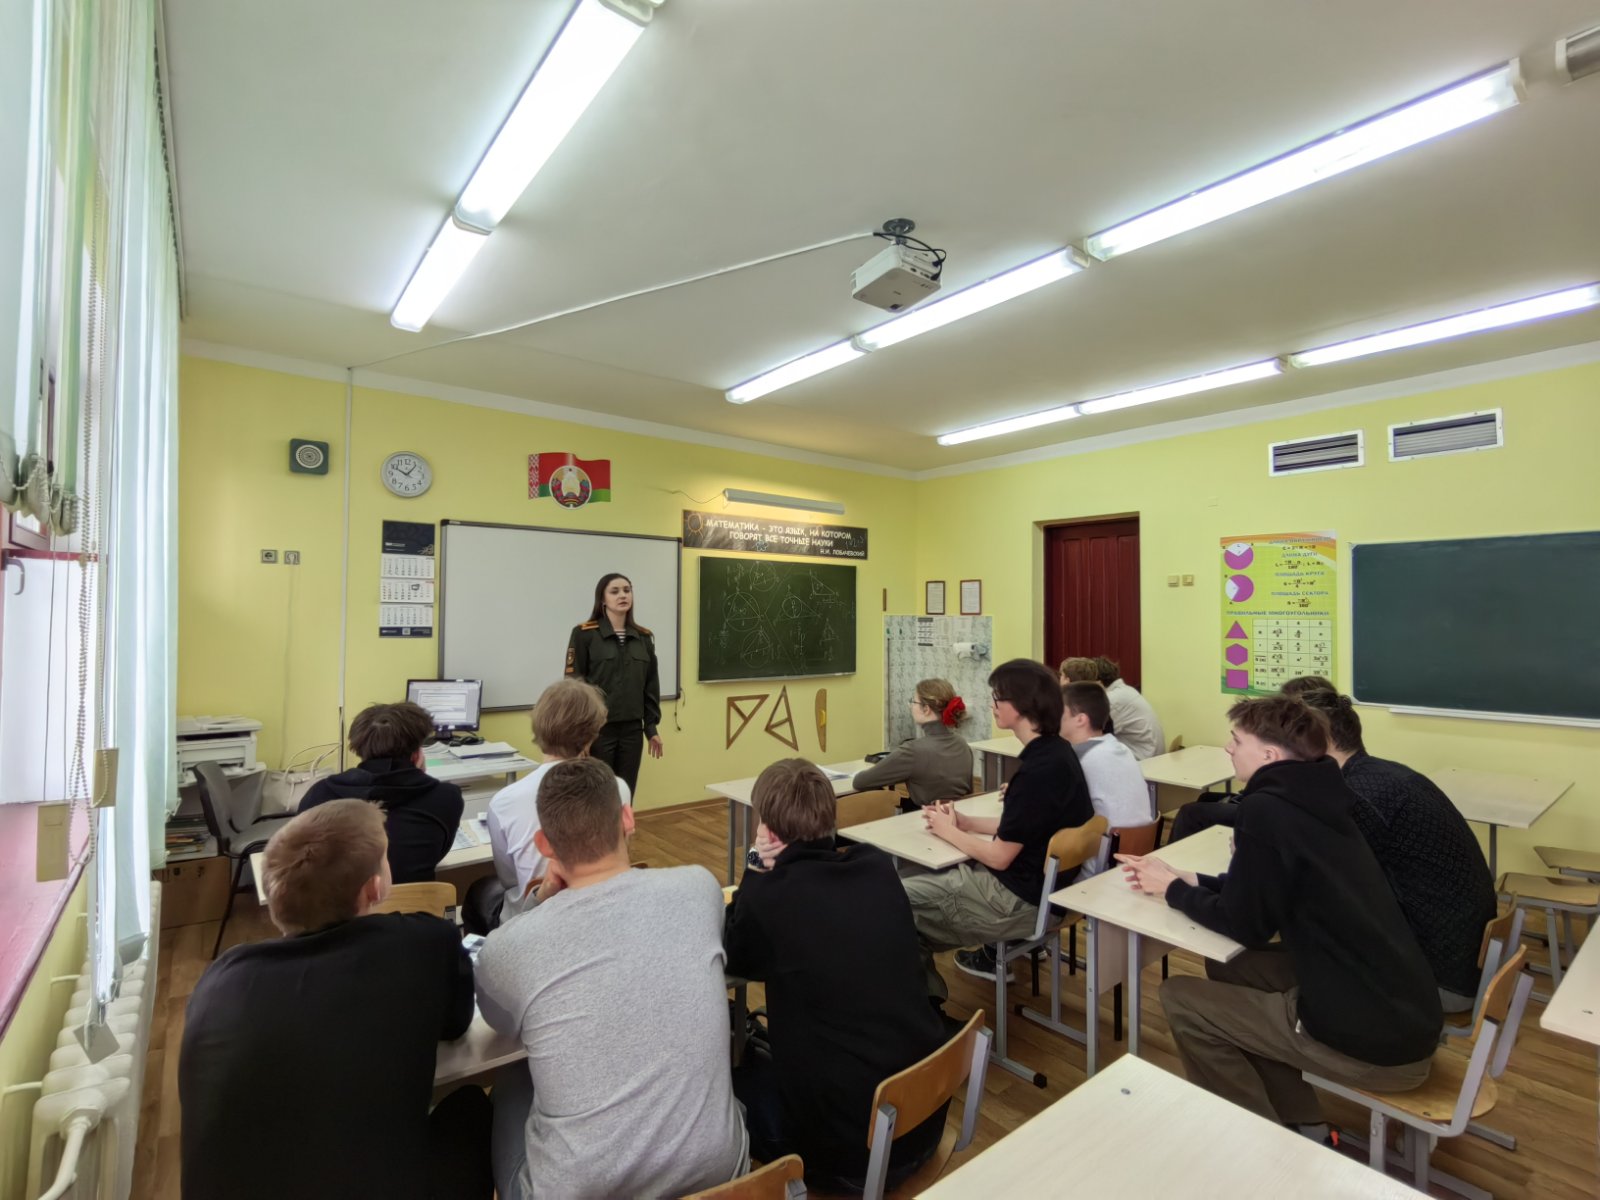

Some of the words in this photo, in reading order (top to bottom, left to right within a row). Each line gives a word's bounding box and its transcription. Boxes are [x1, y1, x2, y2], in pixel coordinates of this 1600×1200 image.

[706, 519, 759, 532] МАТЕМАТИКА
[768, 525, 783, 533] ЭТО
[785, 526, 807, 536] ЯЗЫК,
[821, 530, 851, 539] КОТОРОМ
[729, 531, 762, 542] ГОВОРЯТ
[765, 534, 778, 543] ВСЕ
[781, 535, 810, 546] ТОЧНЫЕ
[811, 539, 834, 547] НАУКИ
[833, 549, 865, 557] ЛОБАЧЕВСКИЙ
